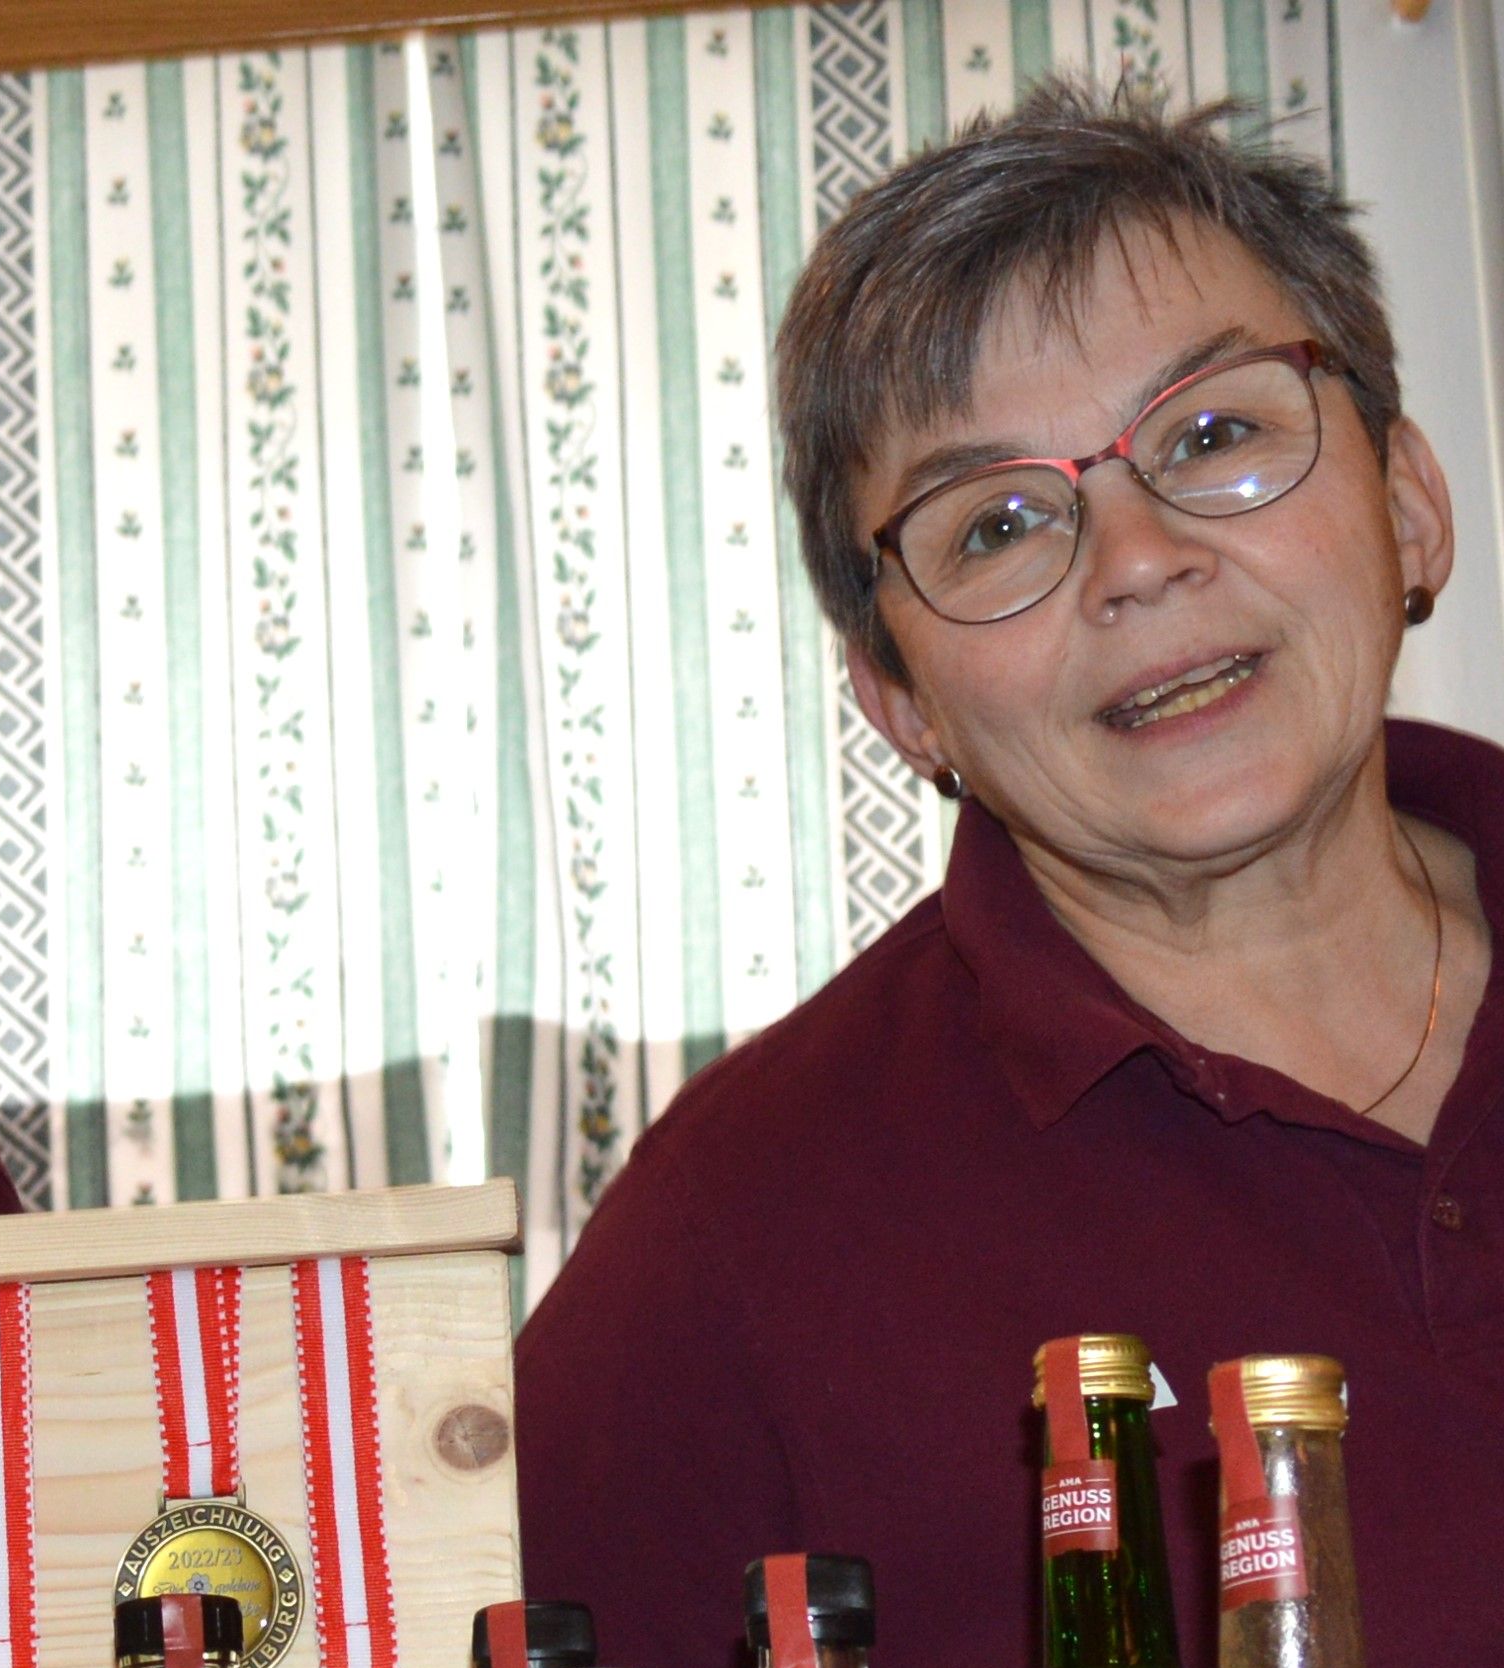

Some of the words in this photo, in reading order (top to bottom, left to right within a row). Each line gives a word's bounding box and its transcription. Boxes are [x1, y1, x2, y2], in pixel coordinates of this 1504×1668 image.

[1059, 1477, 1082, 1488] AMA
[1043, 1488, 1112, 1512] GENUSS
[1043, 1507, 1112, 1531] REGION
[1235, 1518, 1260, 1532] AMA
[124, 1508, 285, 1576] AUSZEICHNUNG
[1220, 1528, 1296, 1559] GENUSS
[168, 1548, 243, 1570] 2022/23
[1221, 1550, 1296, 1581] REGION
